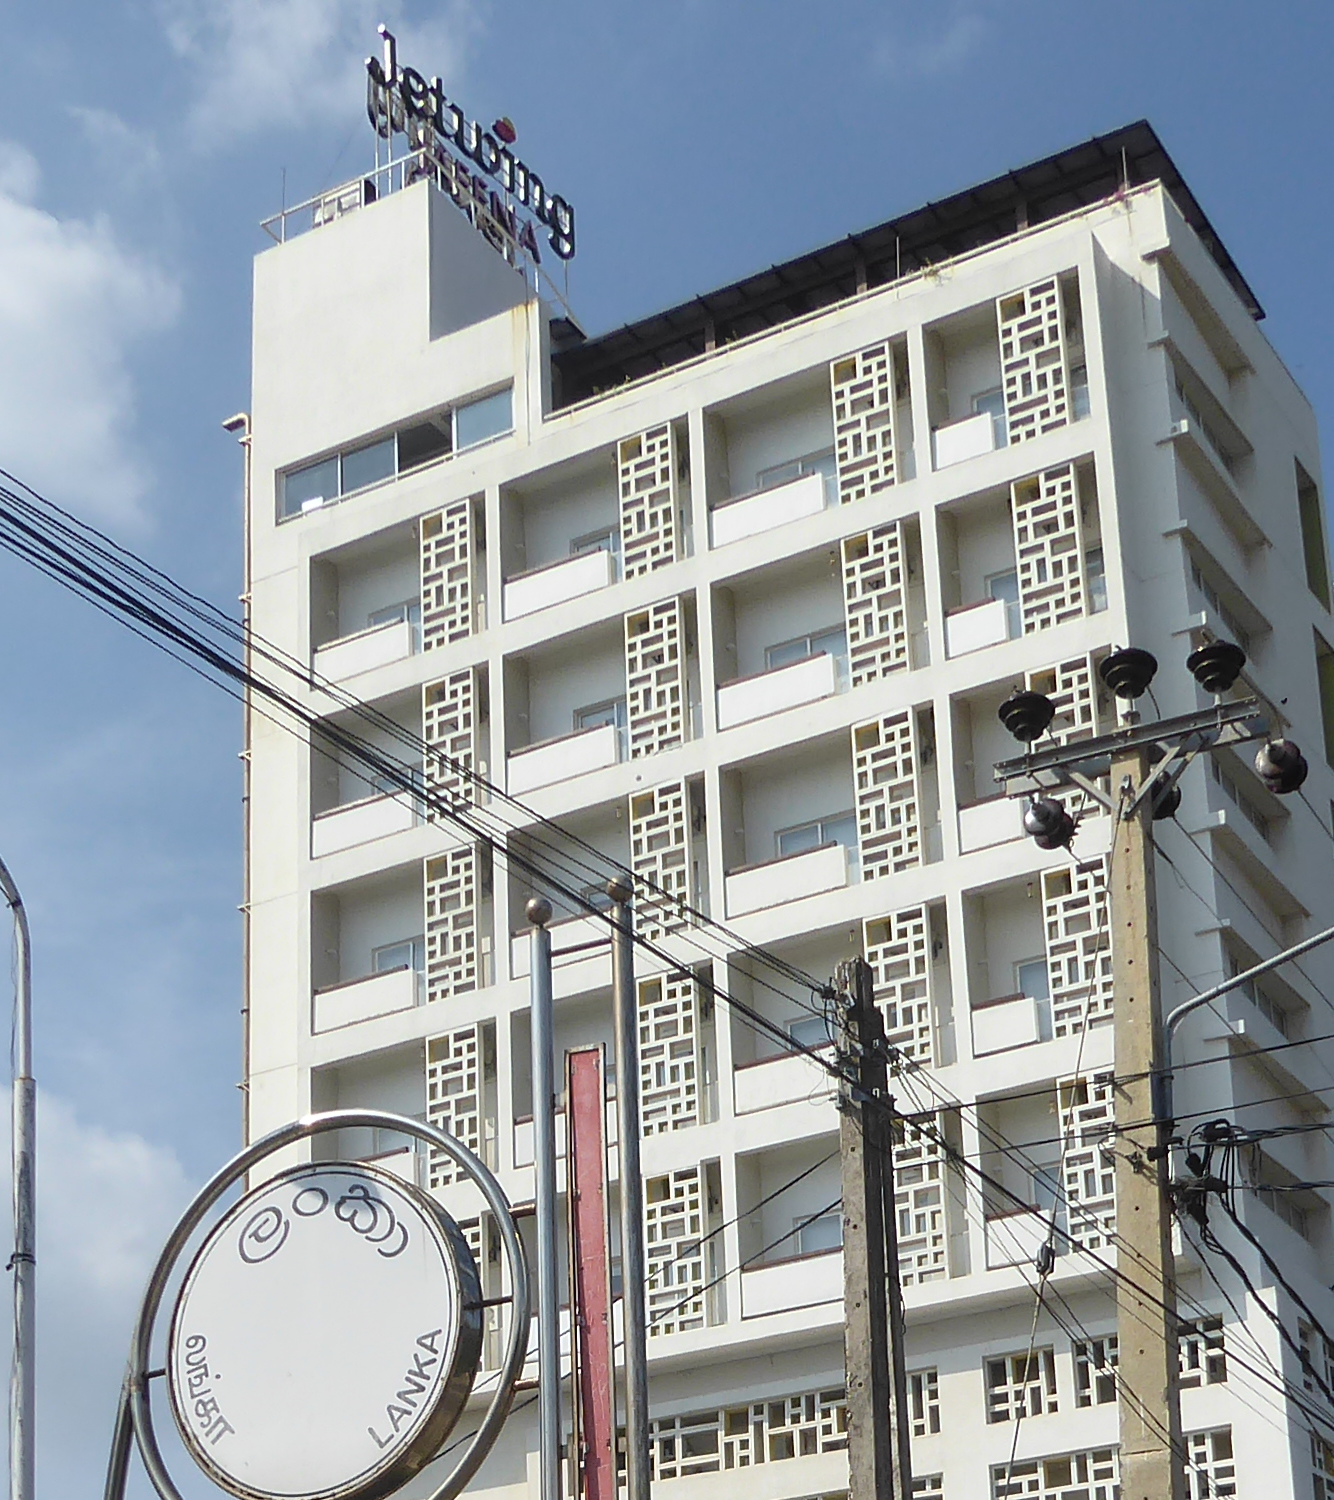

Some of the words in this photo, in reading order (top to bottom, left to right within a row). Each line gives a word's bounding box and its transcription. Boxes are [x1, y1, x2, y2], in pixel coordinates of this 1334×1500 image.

[365, 23, 576, 260] Jetwing
[186, 1334, 235, 1445] லங்கா
[367, 1328, 443, 1450] LANKA
